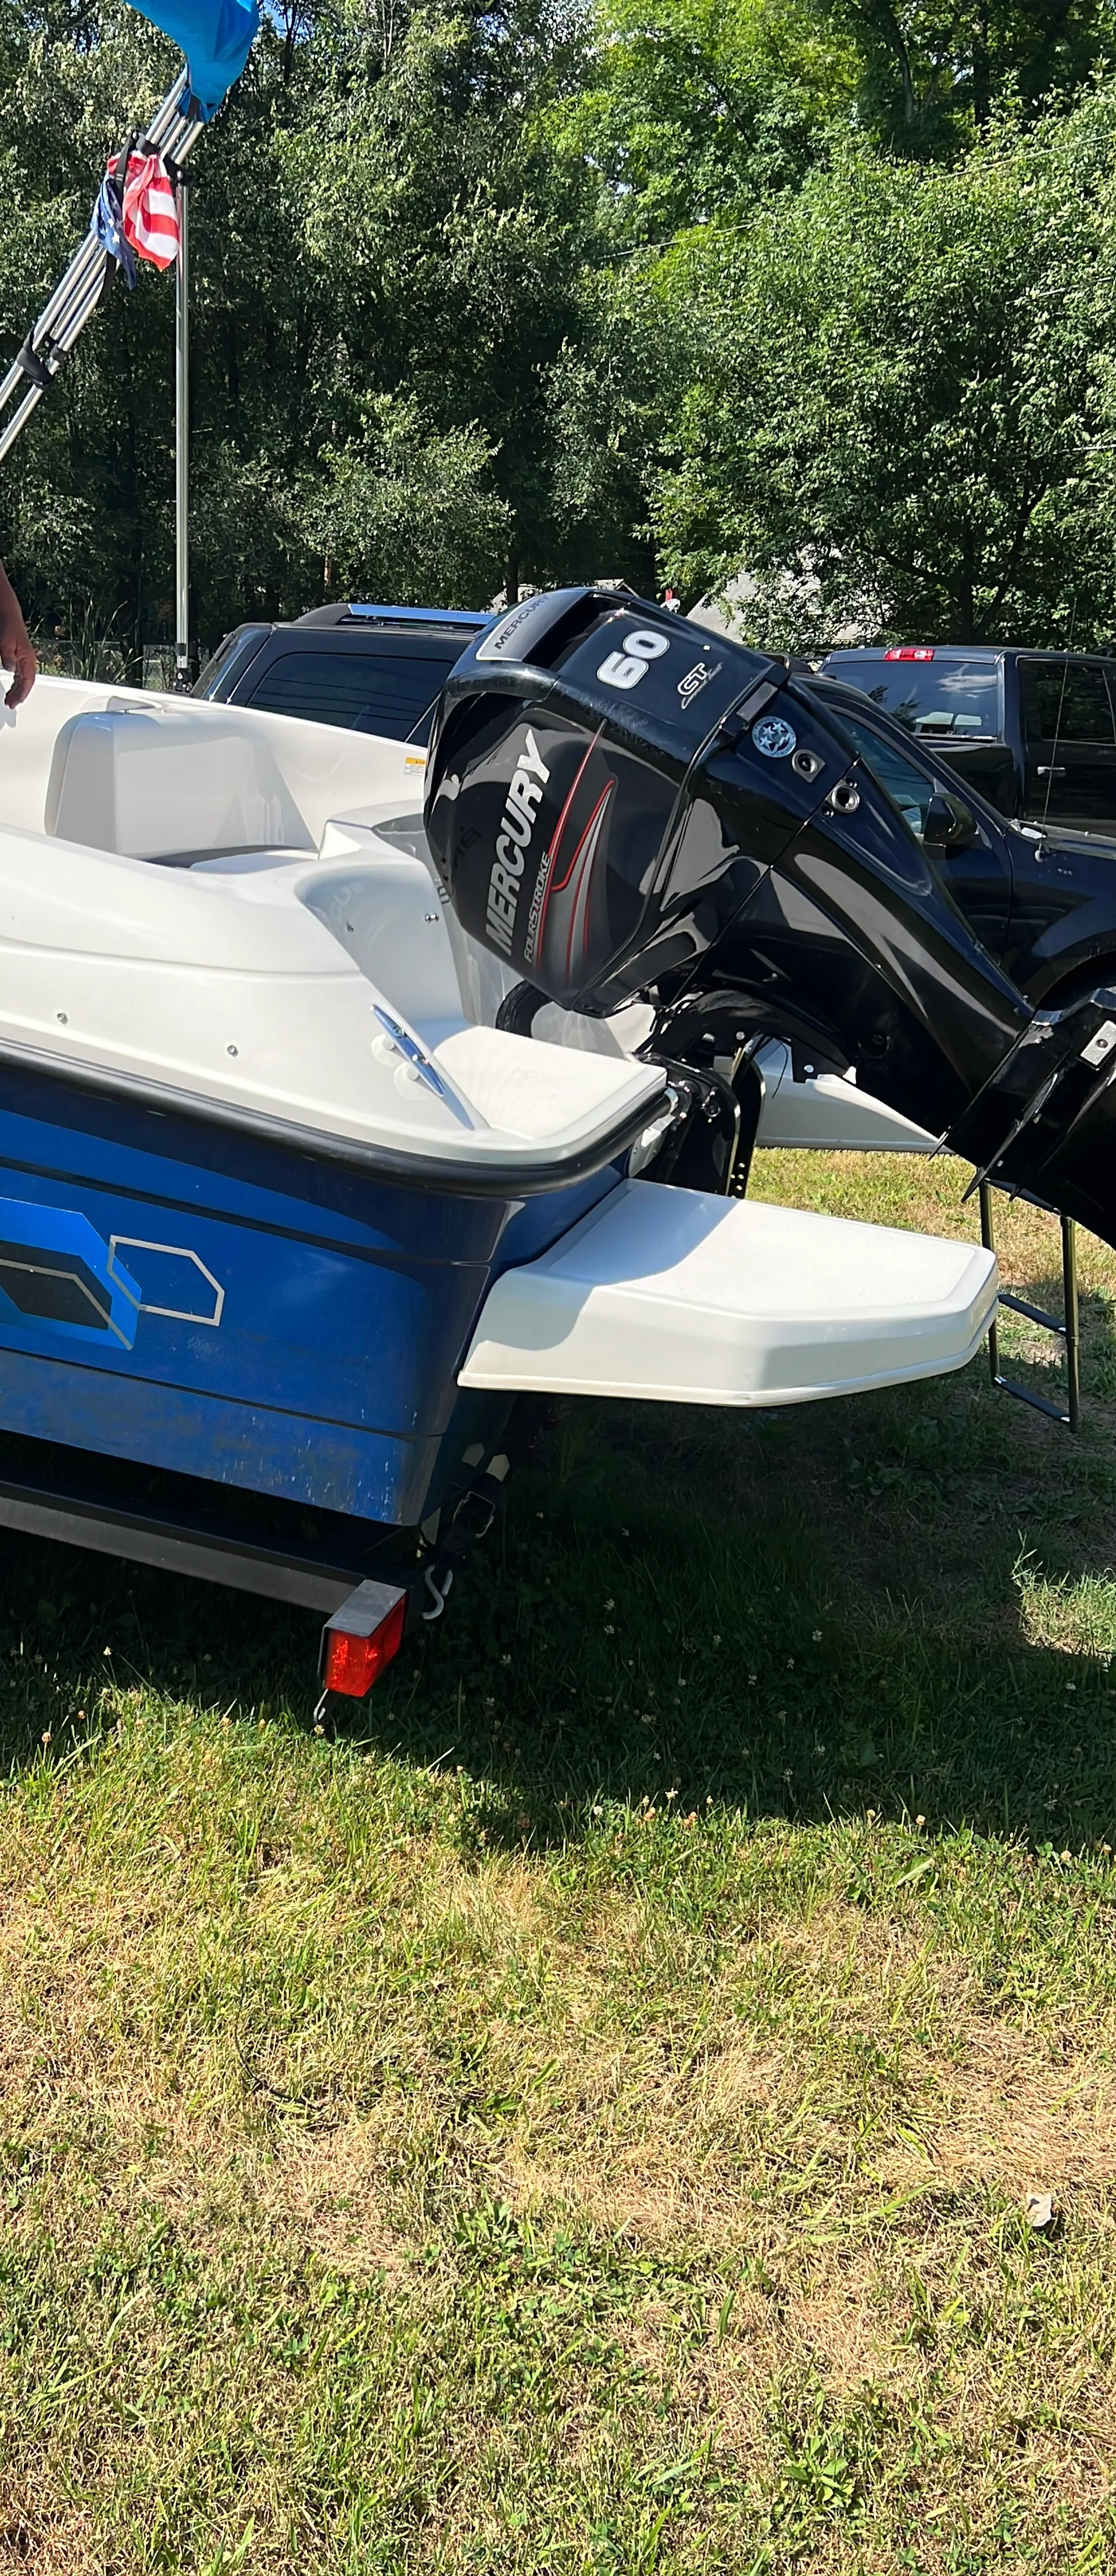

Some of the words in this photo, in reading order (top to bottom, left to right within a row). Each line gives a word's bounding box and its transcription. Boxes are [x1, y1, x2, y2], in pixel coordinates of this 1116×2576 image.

[495, 595, 549, 649] MERCURY
[596, 630, 670, 689] 60
[486, 728, 550, 956] MERCURY
[524, 851, 550, 963] FOURSTROKE
